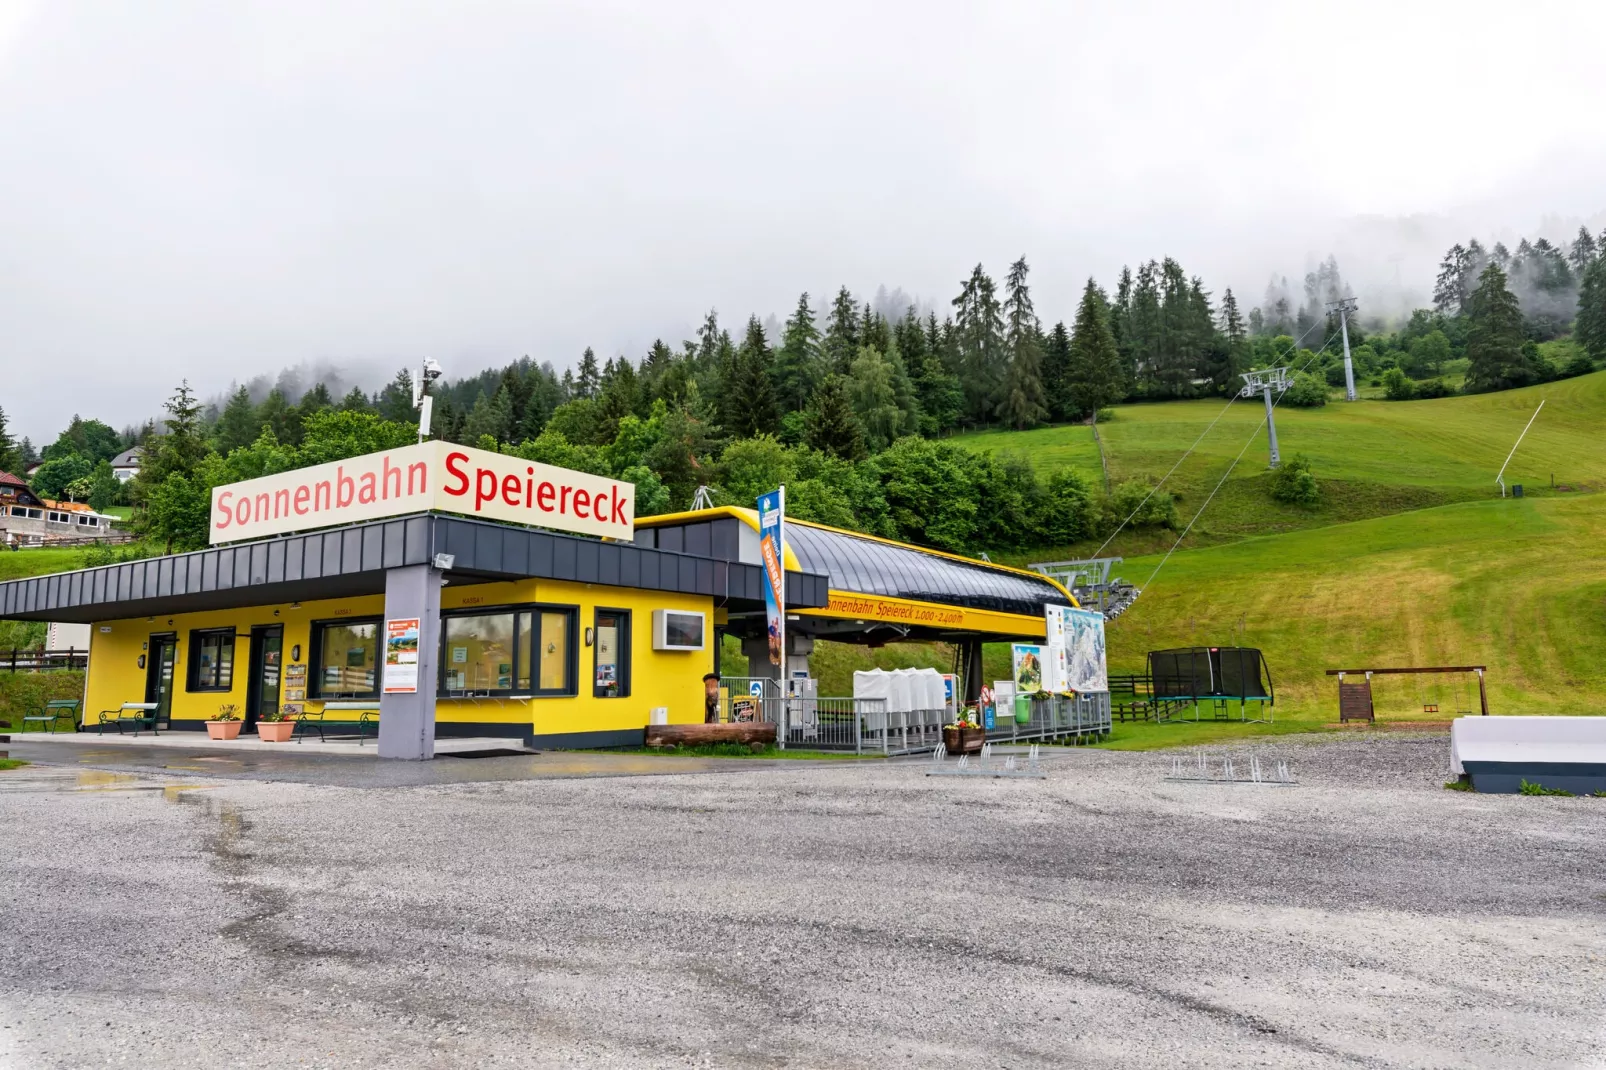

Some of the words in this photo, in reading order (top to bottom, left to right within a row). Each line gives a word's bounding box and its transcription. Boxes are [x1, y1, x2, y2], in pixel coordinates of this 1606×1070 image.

[216, 456, 427, 529] Sonnenbahn
[443, 452, 628, 525] Speiereck
[818, 599, 874, 615] onnenbahn
[876, 602, 914, 618] Speiereck
[915, 610, 934, 621] 1.000
